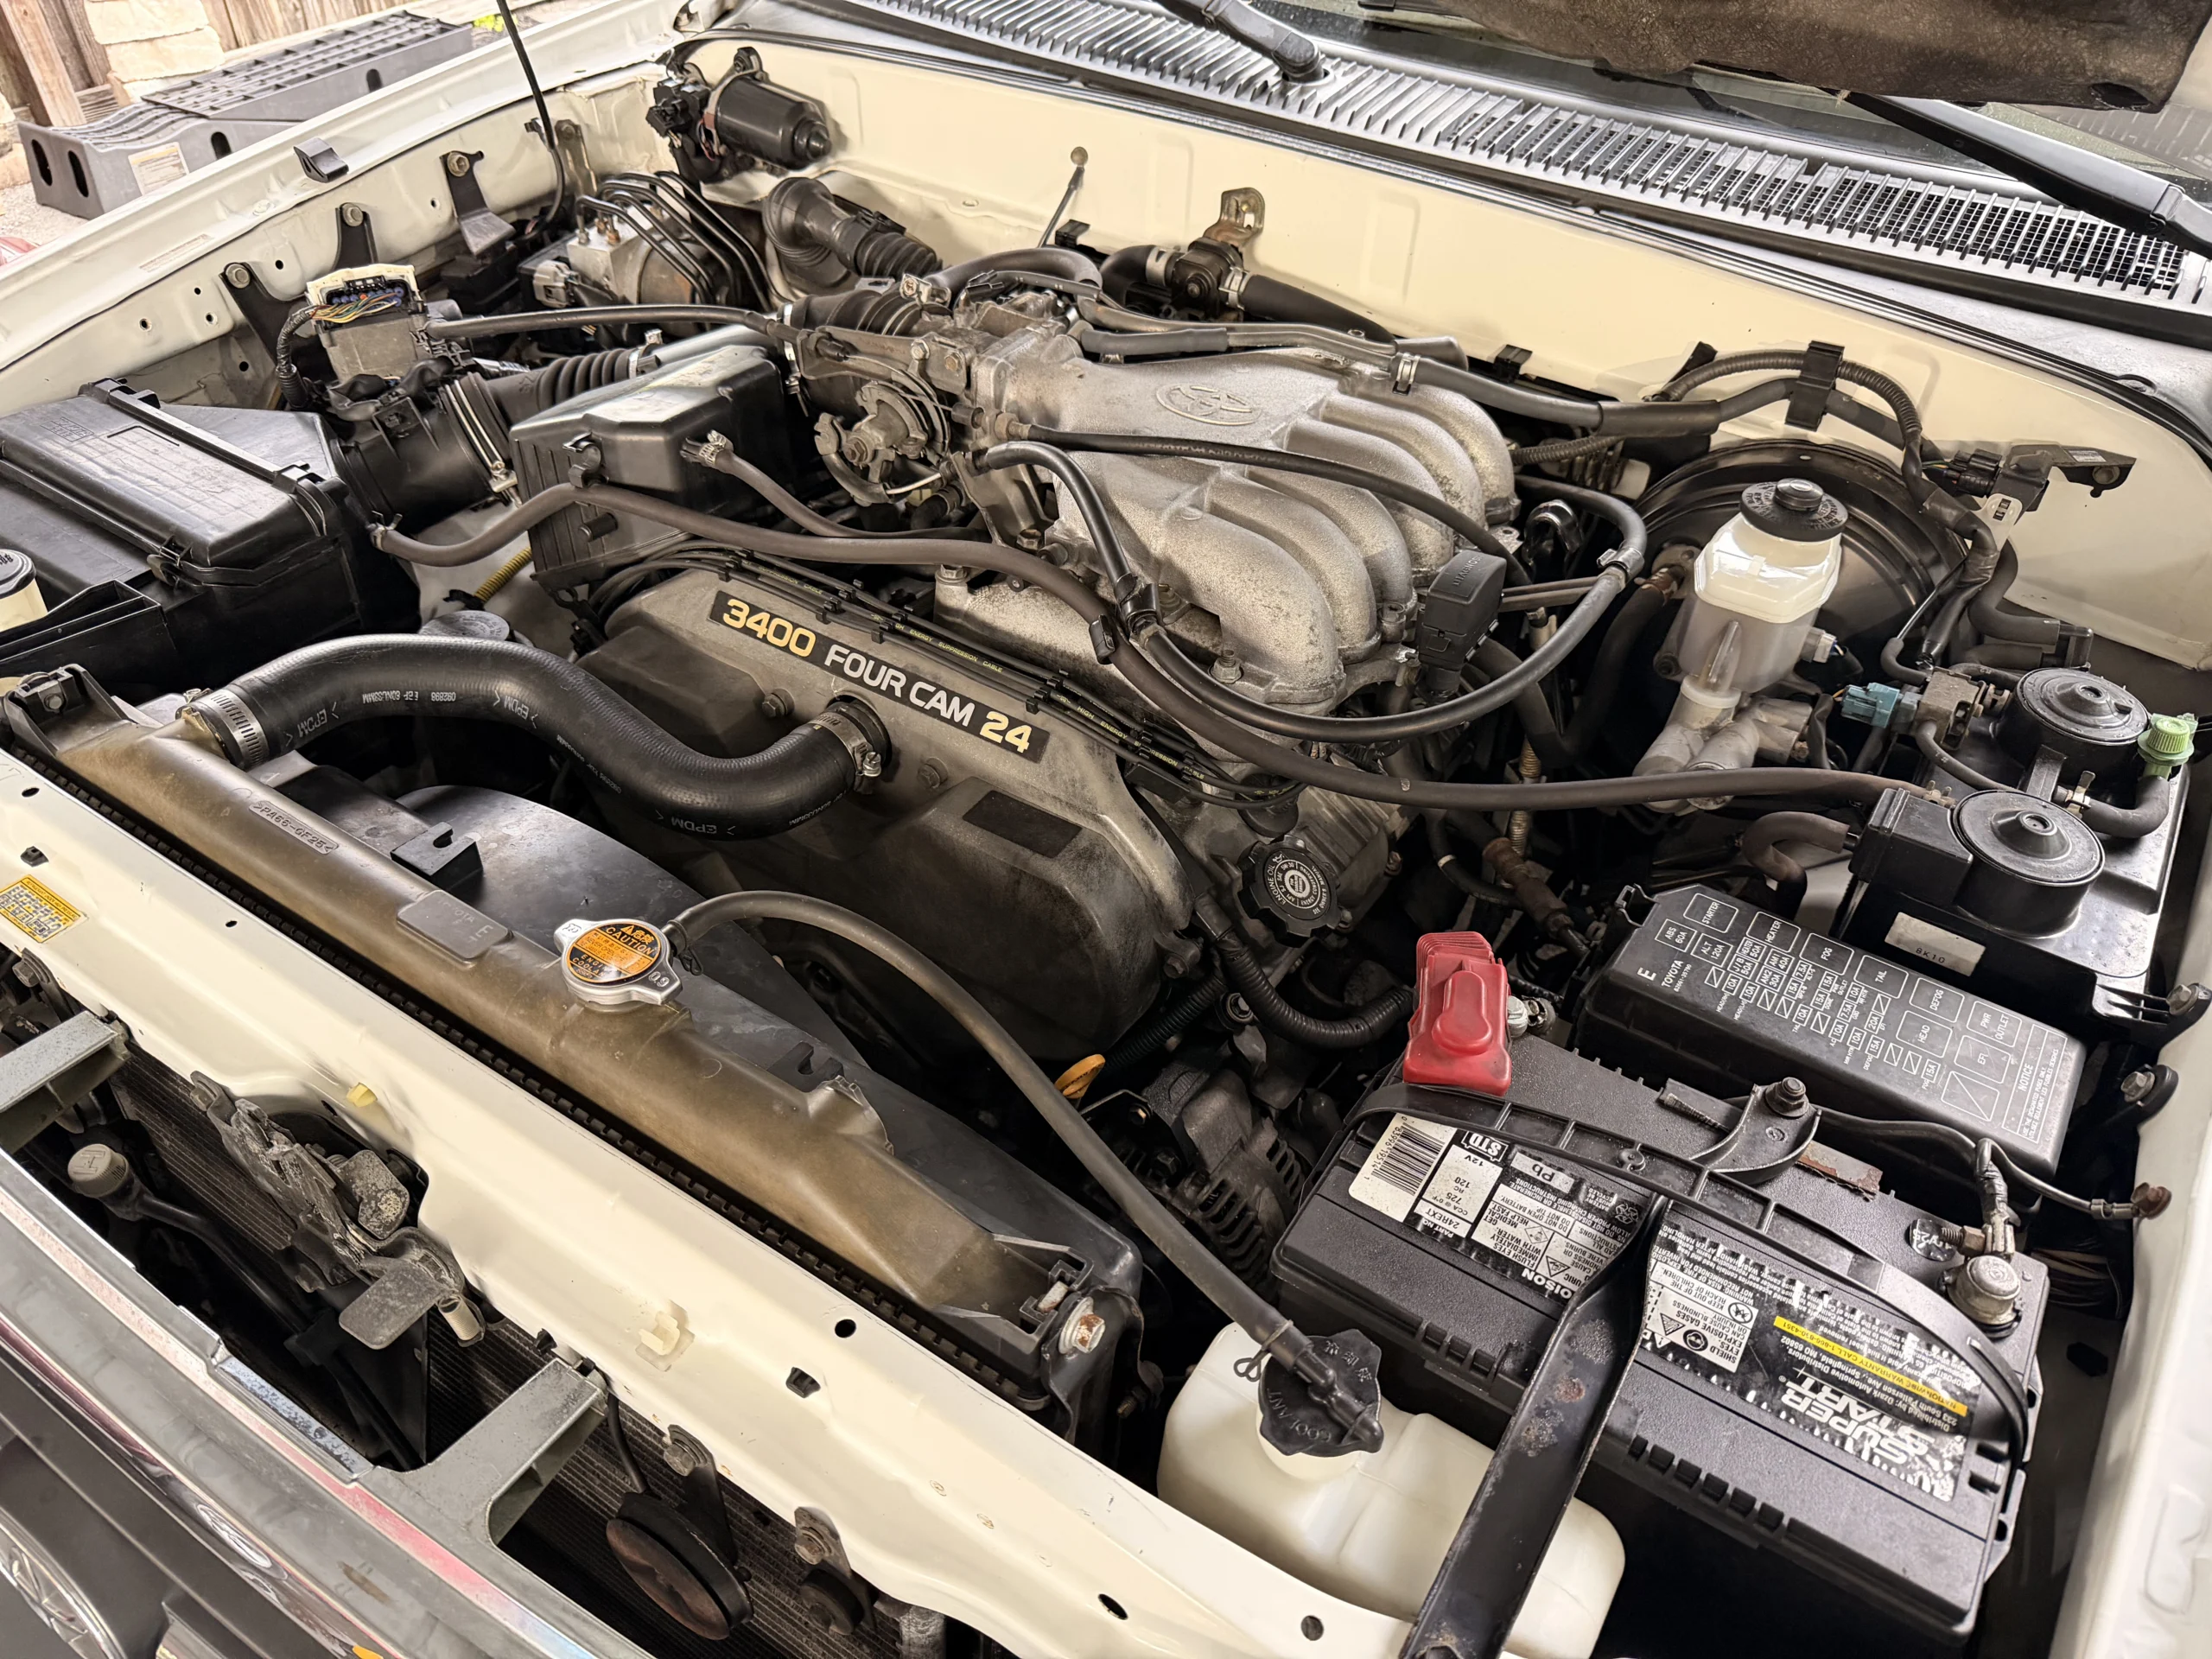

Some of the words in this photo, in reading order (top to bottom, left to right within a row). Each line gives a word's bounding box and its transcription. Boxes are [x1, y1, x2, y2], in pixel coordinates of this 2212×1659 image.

[1451, 553, 1481, 588] DIAGNOS
[909, 628, 932, 642] ENERGY
[938, 641, 977, 662] SUPPRESSION
[982, 660, 1002, 672] CABLE
[721, 598, 818, 659] 3400
[823, 643, 908, 700] FOUR
[908, 678, 975, 728] CAM
[979, 710, 1033, 754] 24
[503, 694, 529, 719] EPDM
[296, 709, 327, 737] EPDM
[1076, 705, 1094, 720] HIGH
[1099, 721, 1128, 740] ENERGY
[1134, 740, 1178, 766] SURESSION
[669, 817, 718, 834] EPDM
[1268, 875, 1286, 905] ENGINE
[1701, 901, 1719, 924] STARTER
[633, 929, 654, 944] 危険
[1664, 925, 1676, 939] ABS
[1675, 930, 1687, 944] 60A
[1764, 919, 1782, 943] HEATER
[605, 925, 654, 956] CAUTION
[1700, 941, 1713, 954] ALT
[1740, 938, 1753, 955] HEATER
[1710, 944, 1724, 959] 120A
[1750, 944, 1762, 957] 50A
[1820, 946, 1833, 960] FOG
[1732, 957, 1745, 971] J/B
[1769, 952, 1781, 966] AM1
[1777, 956, 1789, 969] 40A
[1637, 967, 1656, 981] E
[1662, 959, 1683, 988] TOYOTA
[1740, 961, 1753, 975] 50A
[1795, 963, 1808, 977] 7.5A
[1874, 969, 1887, 982] TAIL
[648, 971, 670, 987] 0.9
[1725, 976, 1738, 990] 10A
[1760, 969, 1772, 983] AM2
[1769, 973, 1781, 987] 30A
[1821, 975, 1834, 988] 15A
[1744, 984, 1756, 997] 10A
[1786, 980, 1800, 995] 15A
[1837, 979, 1848, 995] OUTLET
[1849, 986, 1860, 998] 10A
[1814, 992, 1826, 1006] 15A
[1929, 988, 1944, 1010] DEFOG
[1796, 1007, 1808, 1022] 10A
[1840, 1003, 1853, 1019] 7.5A
[1868, 1015, 1880, 1029] 20A
[1980, 1012, 1992, 1027] PWR
[1994, 1014, 2010, 1039] OUTLET
[1833, 1023, 1845, 1037] 10A
[1850, 1030, 1863, 1045] 10A
[1917, 1024, 1930, 1042] HEAD
[1869, 1038, 1881, 1052] 15A
[1863, 1054, 1873, 1070] DEFOG
[1976, 1052, 1988, 1065] EFI
[1924, 1063, 1937, 1077] 15A
[2018, 1063, 2033, 1091] NOTICE
[1922, 1079, 1930, 1089] FOG
[1467, 1130, 1502, 1157] STD
[1463, 1153, 1484, 1167] 12V
[1529, 1161, 1555, 1182] Pb
[1452, 1185, 1465, 1193] RC
[1454, 1176, 1471, 1188] 120
[1445, 1191, 1462, 1205] 725
[1499, 1194, 1527, 1212] BATTERY.
[1452, 1204, 1468, 1216] CCA
[1490, 1202, 1510, 1217] FAST.
[1527, 1208, 1544, 1221] OPEN
[1535, 1205, 1547, 1215] TIP.
[1547, 1211, 1560, 1222] NOT
[1421, 1217, 1433, 1228] NO.
[1425, 1206, 1459, 1229] 24REXT
[1484, 1214, 1497, 1225] GET
[1486, 1207, 1518, 1228] MEDICAL
[1510, 1211, 1529, 1225] HELP
[1543, 1216, 1557, 1227] NOT
[1560, 1217, 1570, 1226] DO
[1433, 1224, 1453, 1237] PART
[1557, 1222, 1567, 1231] DO
[1494, 1226, 1526, 1247] WATER.
[1490, 1233, 1538, 1262] IMMEDIATELY
[1492, 1242, 1512, 1255] EYES
[1525, 1243, 1541, 1255] WITH
[1562, 1239, 1586, 1255] BURNS.
[1511, 1251, 1535, 1268] FLUSH
[1570, 1259, 1591, 1274] CAUSE
[1521, 1267, 1573, 1300] OISON
[1658, 1266, 1694, 1289] CHILDREN.
[1669, 1279, 1683, 1290] THE
[1682, 1286, 1694, 1296] OF
[1693, 1284, 1704, 1294] OF
[1694, 1291, 1707, 1302] OUT
[1703, 1288, 1726, 1305] REACH
[1671, 1299, 1708, 1322] BLINDNESS
[1706, 1297, 1724, 1311] KEEP
[1675, 1309, 1700, 1326] GASES
[1707, 1318, 1733, 1335] CAUSE
[1736, 1325, 1747, 1335] OR
[1700, 1322, 1743, 1348] EXPLOSIVE
[1732, 1330, 1745, 1340] CAN
[1780, 1334, 1804, 1351] 65802
[1708, 1344, 1737, 1363] SHIELD
[1716, 1338, 1739, 1355] EYES.
[1803, 1345, 1818, 1358] MO
[1784, 1345, 1830, 1373] Distributors,
[1835, 1347, 1858, 1363] CALL
[1817, 1351, 1862, 1379] Springfield,
[1858, 1357, 1904, 1384] WARRANTY
[1829, 1368, 1872, 1394] Automotive
[1871, 1388, 1895, 1406] Ozark
[1893, 1397, 1908, 1410] by:
[1267, 1388, 1331, 1441] COOLANT
[1789, 1370, 1936, 1457] START
[1784, 1389, 1910, 1465] SUPER
